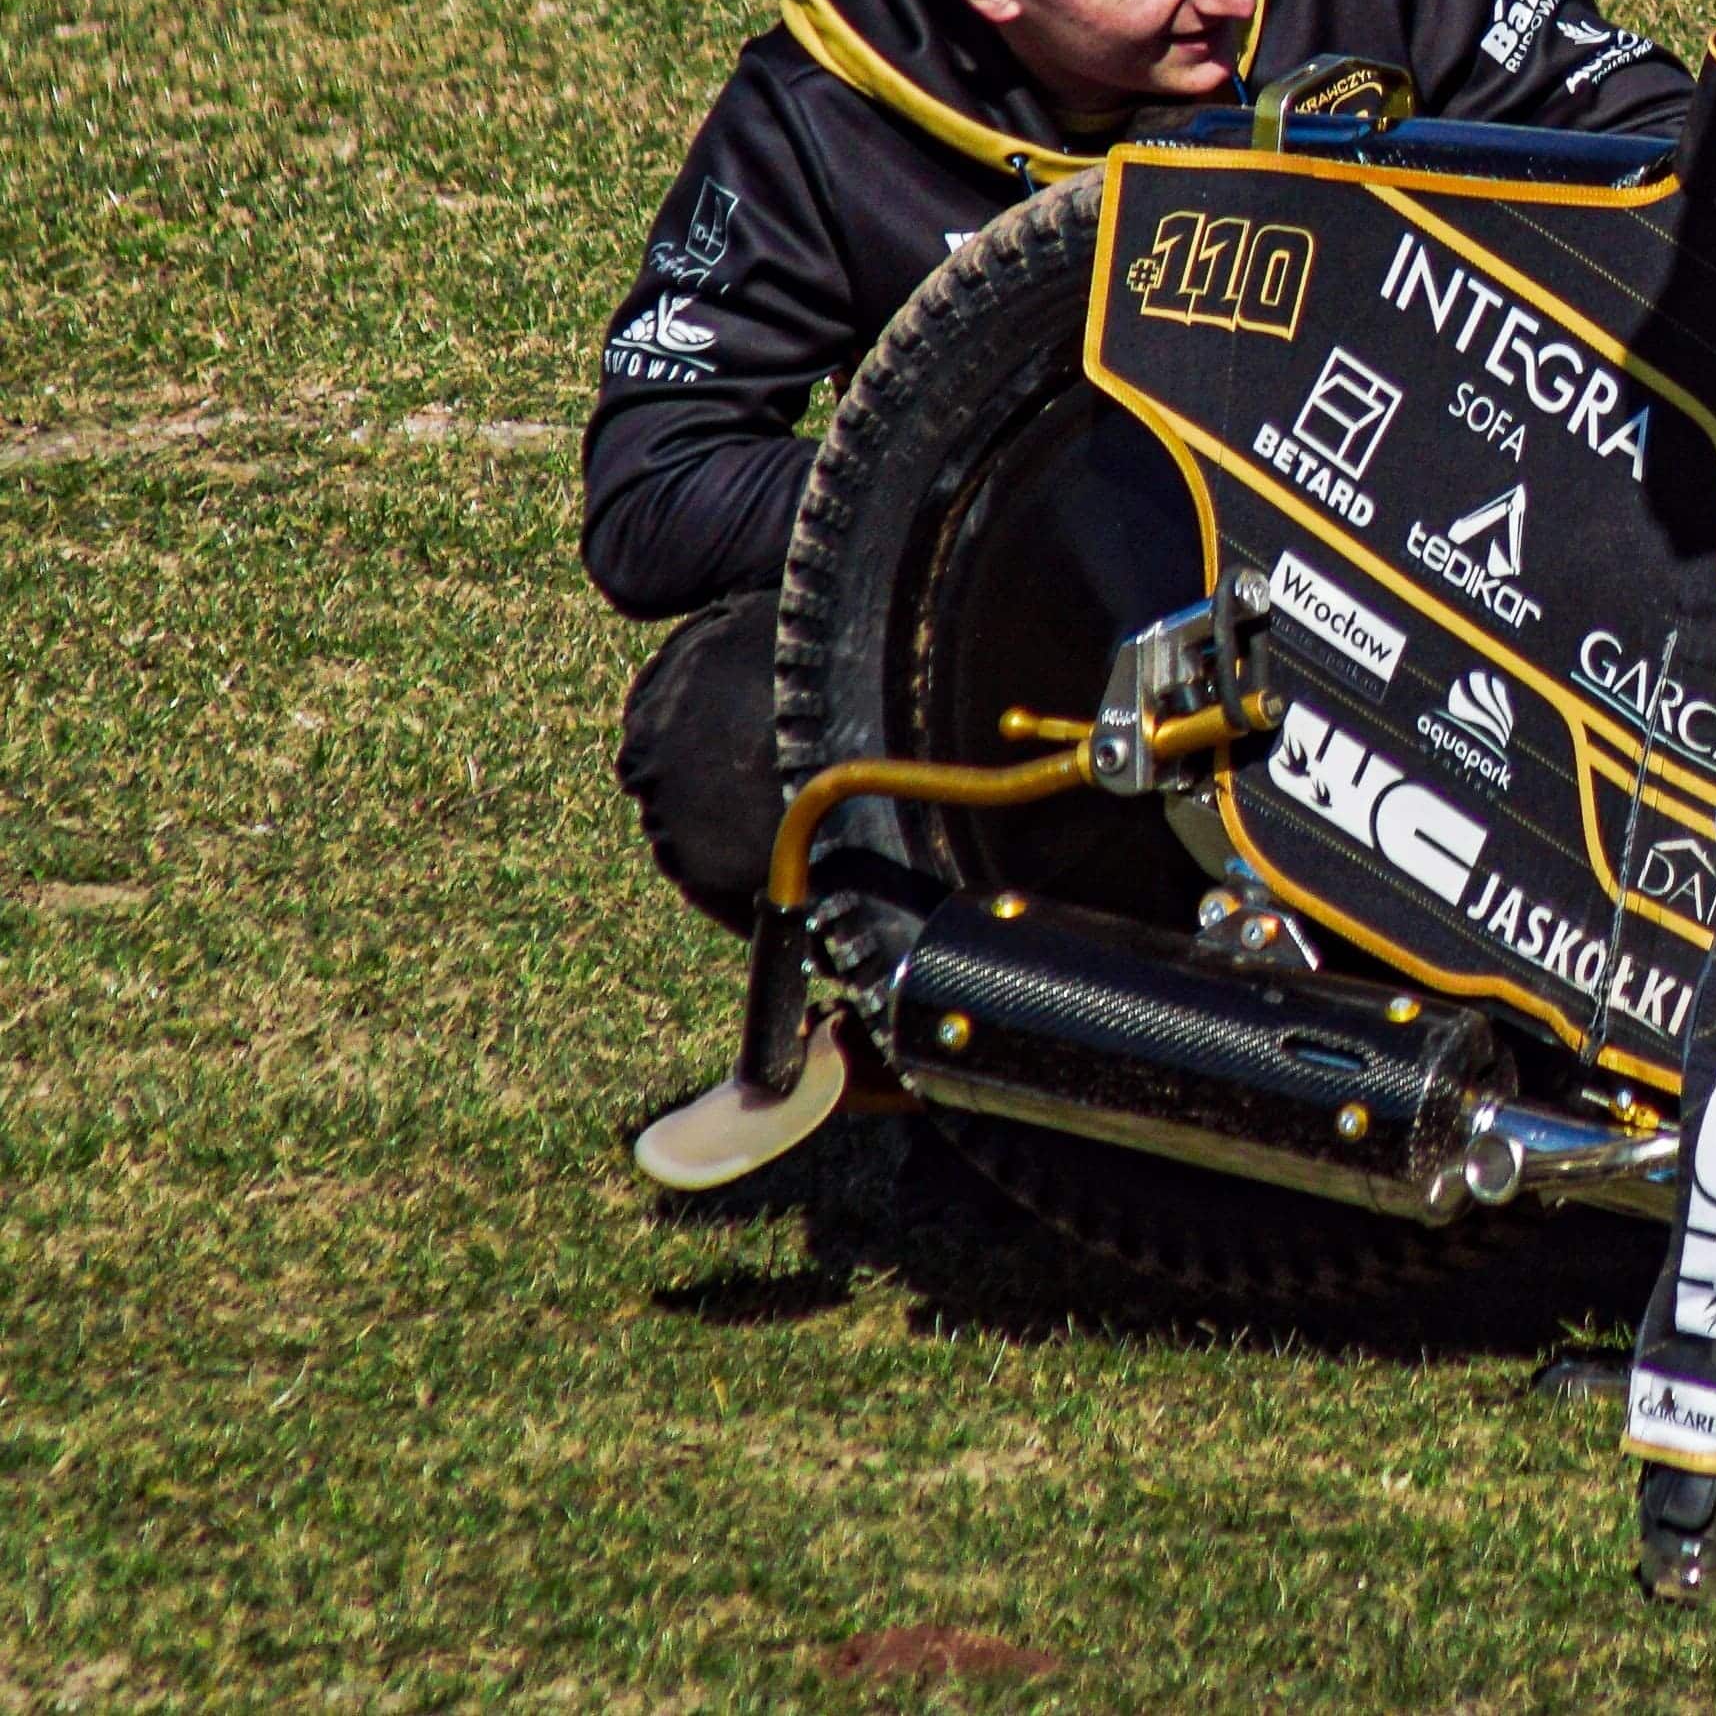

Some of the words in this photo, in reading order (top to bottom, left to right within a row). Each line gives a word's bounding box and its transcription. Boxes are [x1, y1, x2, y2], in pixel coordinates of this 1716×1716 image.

[1295, 69, 1374, 115] KRAWCZY
[1126, 210, 1315, 342] #110
[1379, 232, 1650, 483] INTEGRA
[1448, 382, 1526, 464] SOFA
[1252, 423, 1375, 528] BETARD
[1282, 564, 1393, 664] Wrocław
[1416, 714, 1512, 792] aquapark
